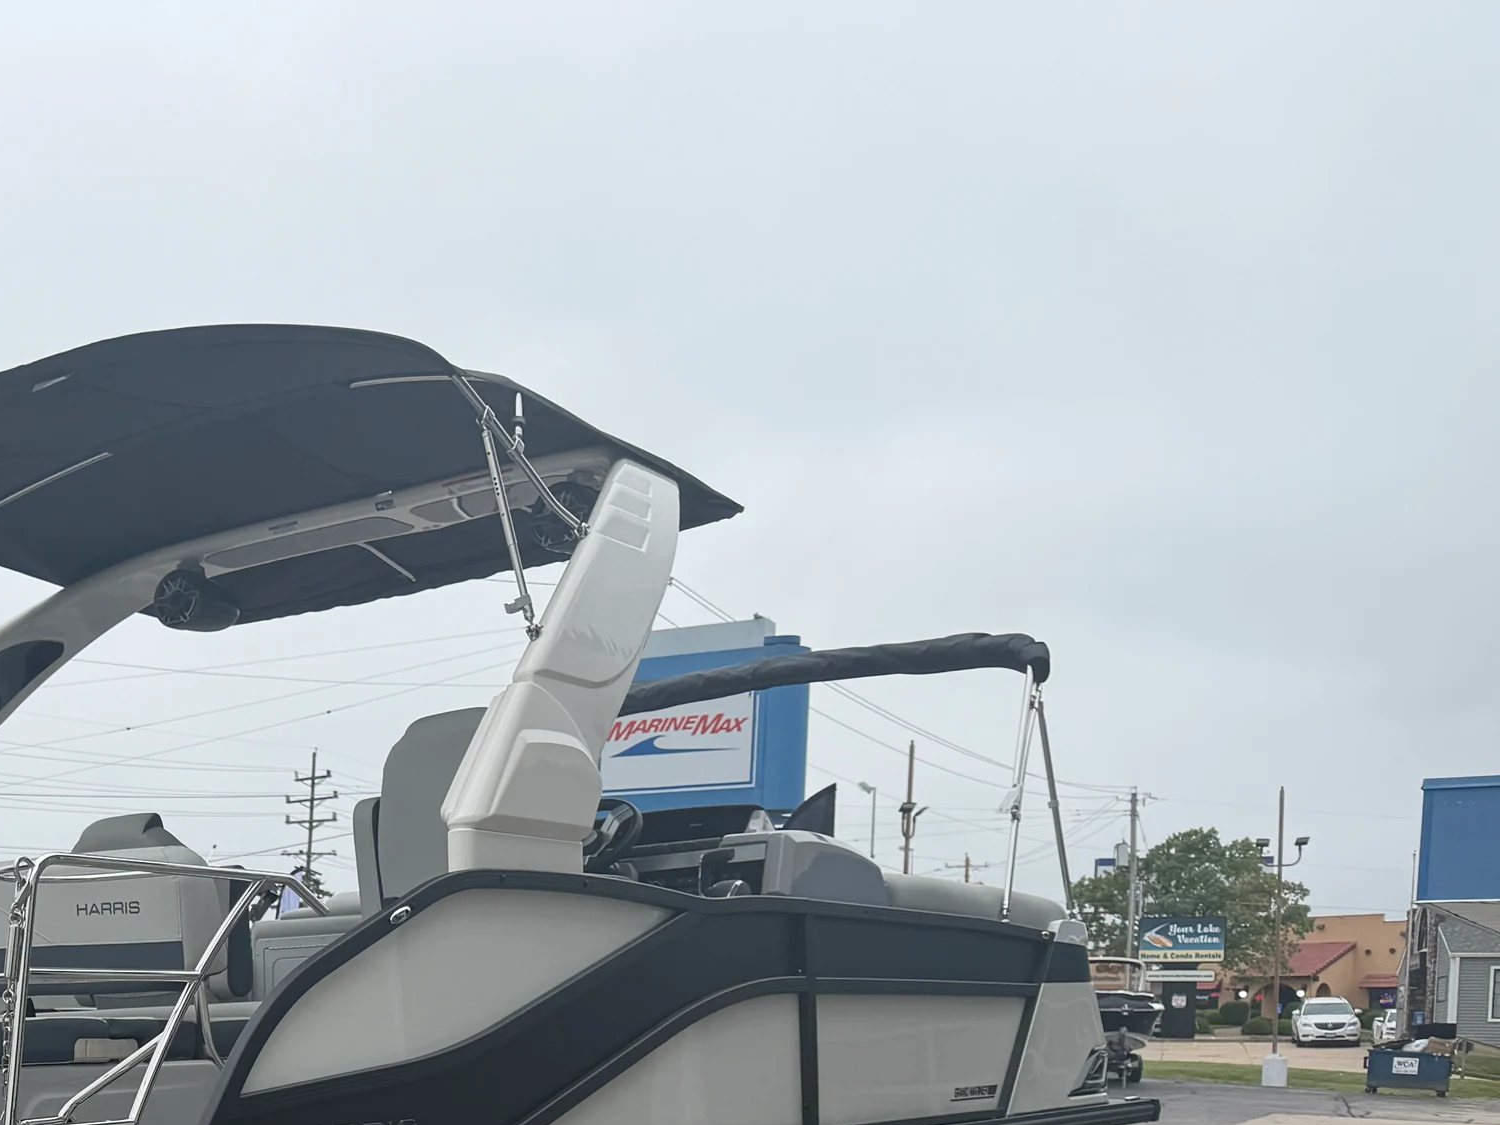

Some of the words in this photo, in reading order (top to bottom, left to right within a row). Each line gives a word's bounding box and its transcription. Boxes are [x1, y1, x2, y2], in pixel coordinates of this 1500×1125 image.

[76, 900, 141, 917] HARRIS
[1168, 923, 1195, 936] Your
[1197, 923, 1221, 934] Lake
[1177, 934, 1220, 944] Vacation
